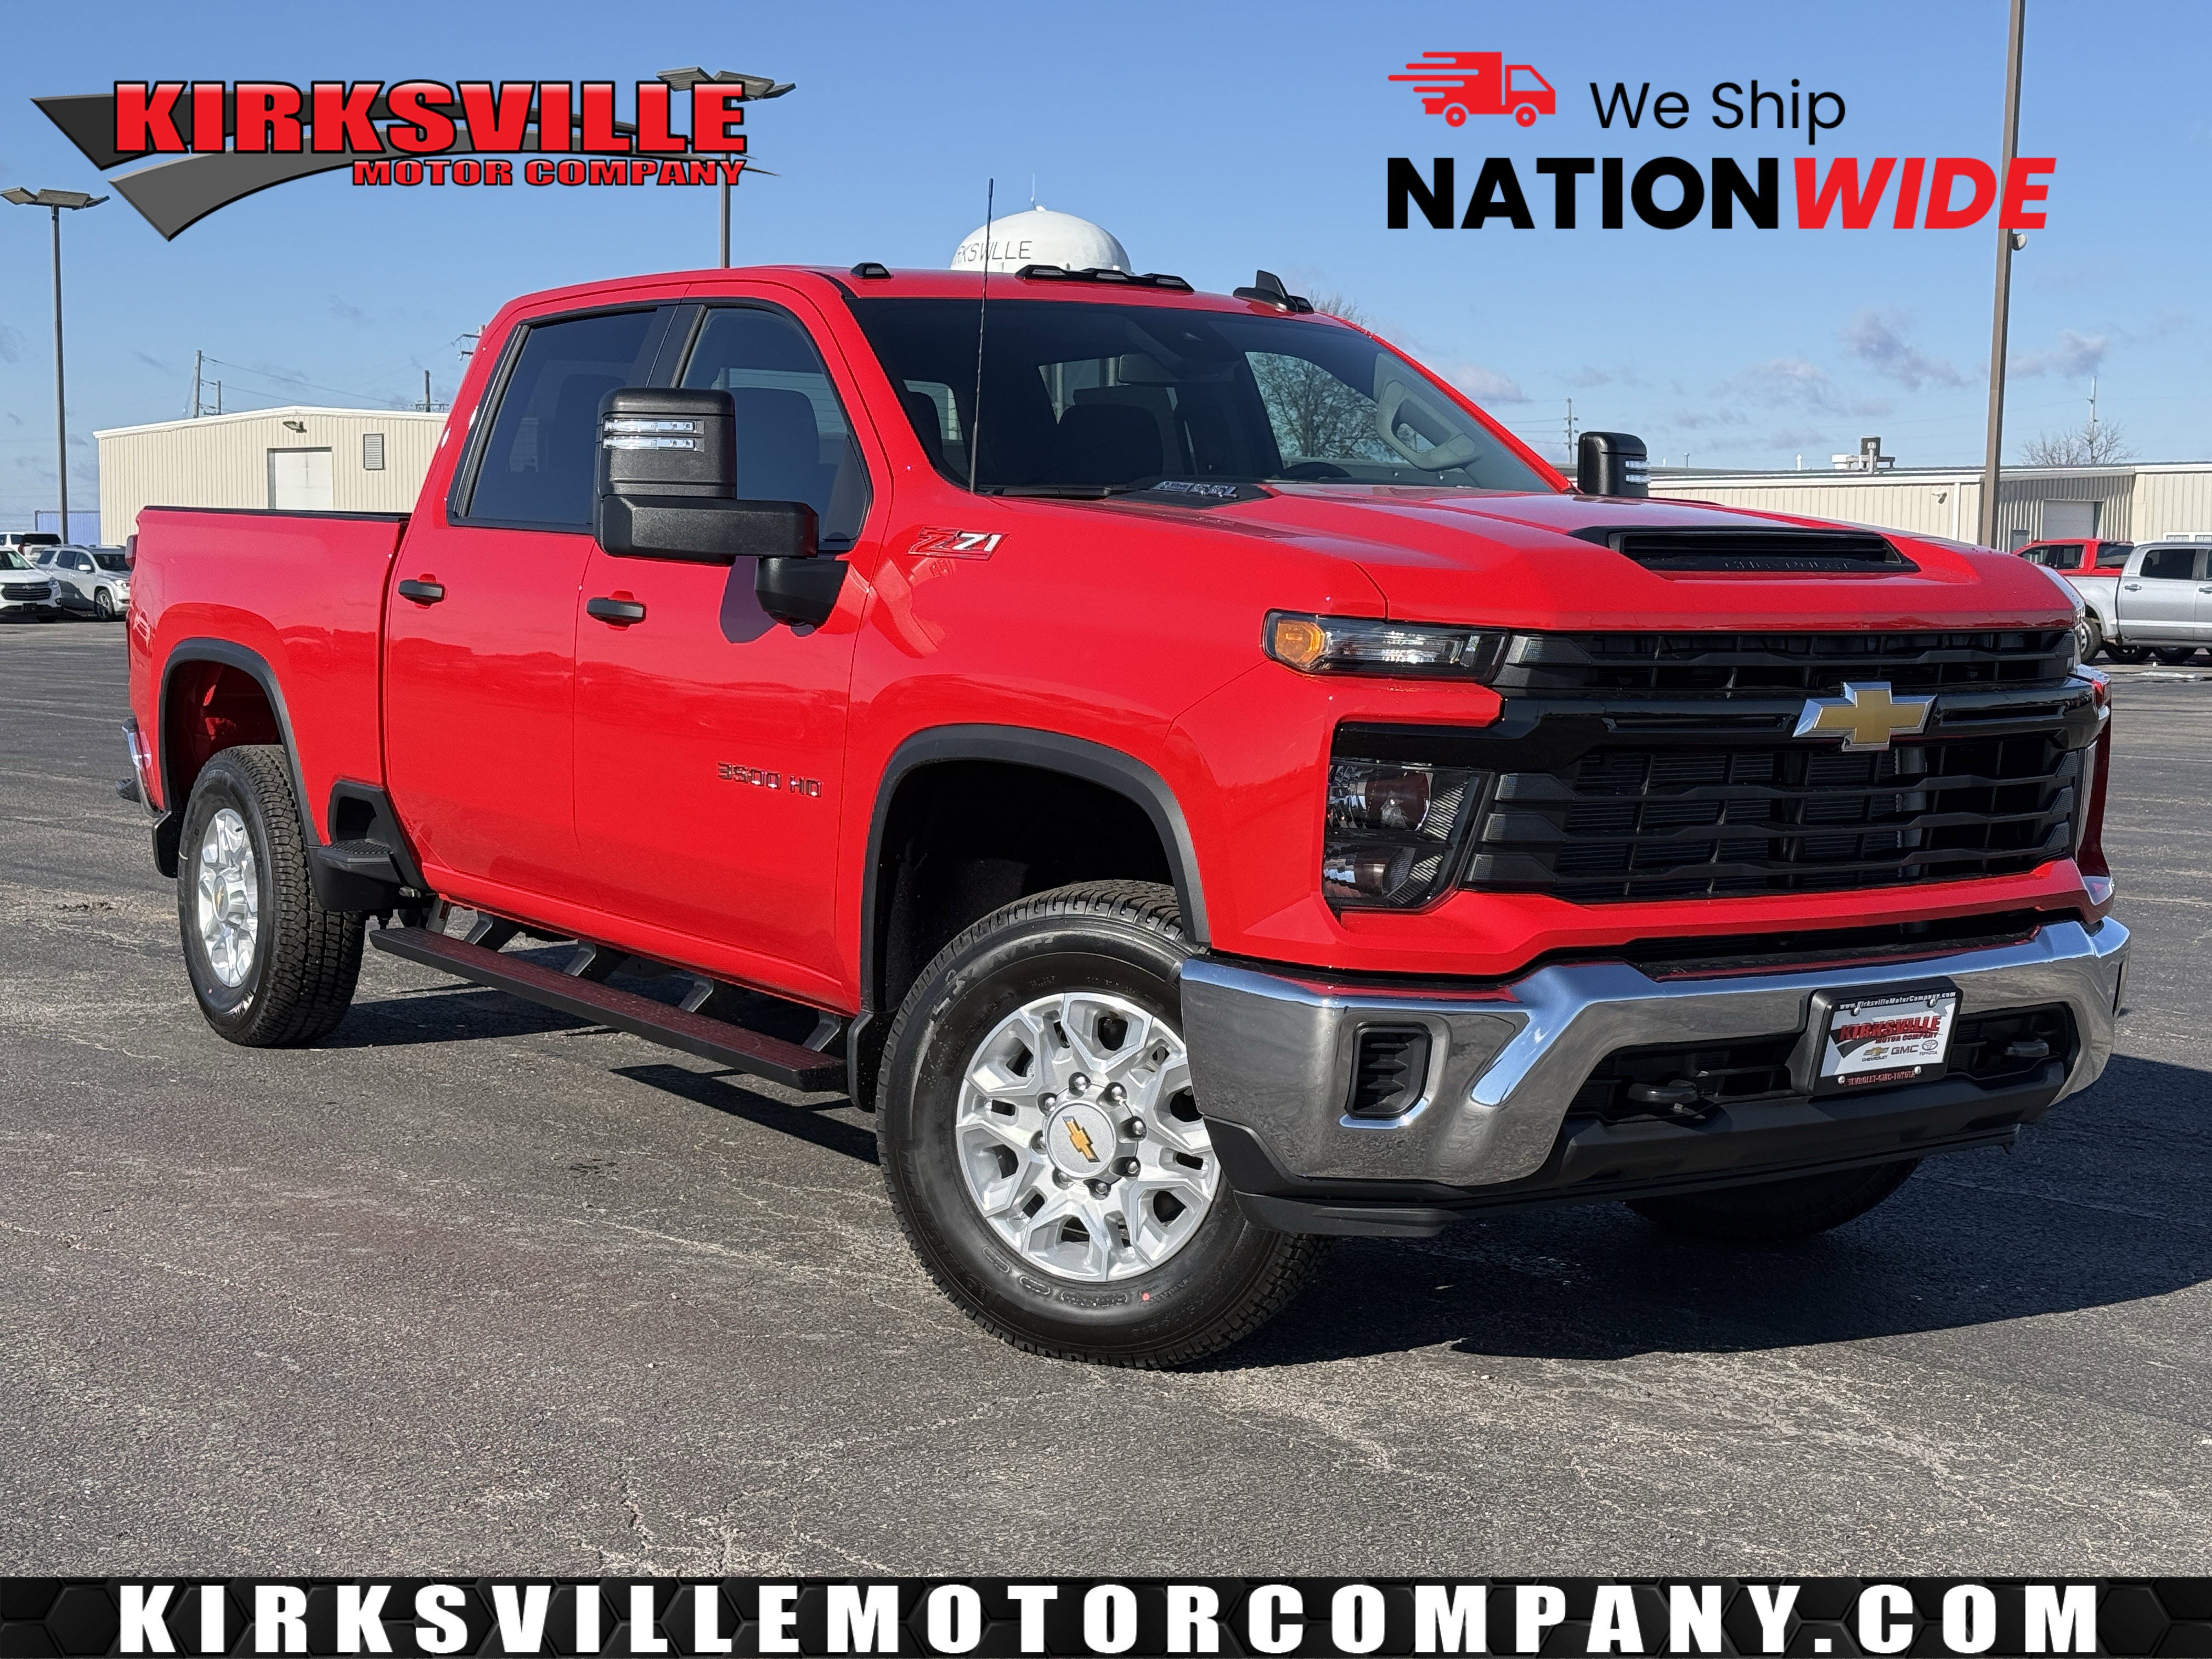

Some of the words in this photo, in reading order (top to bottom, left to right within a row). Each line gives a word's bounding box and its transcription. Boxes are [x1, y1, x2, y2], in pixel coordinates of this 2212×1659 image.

[906, 527, 1010, 561] Z71
[789, 774, 822, 798] HD
[1839, 1015, 1942, 1042] KIRKSVILLE
[1875, 1035, 1901, 1044] MOTOR
[1902, 1031, 1938, 1041] COMPANY
[1891, 1044, 1920, 1056] GMC
